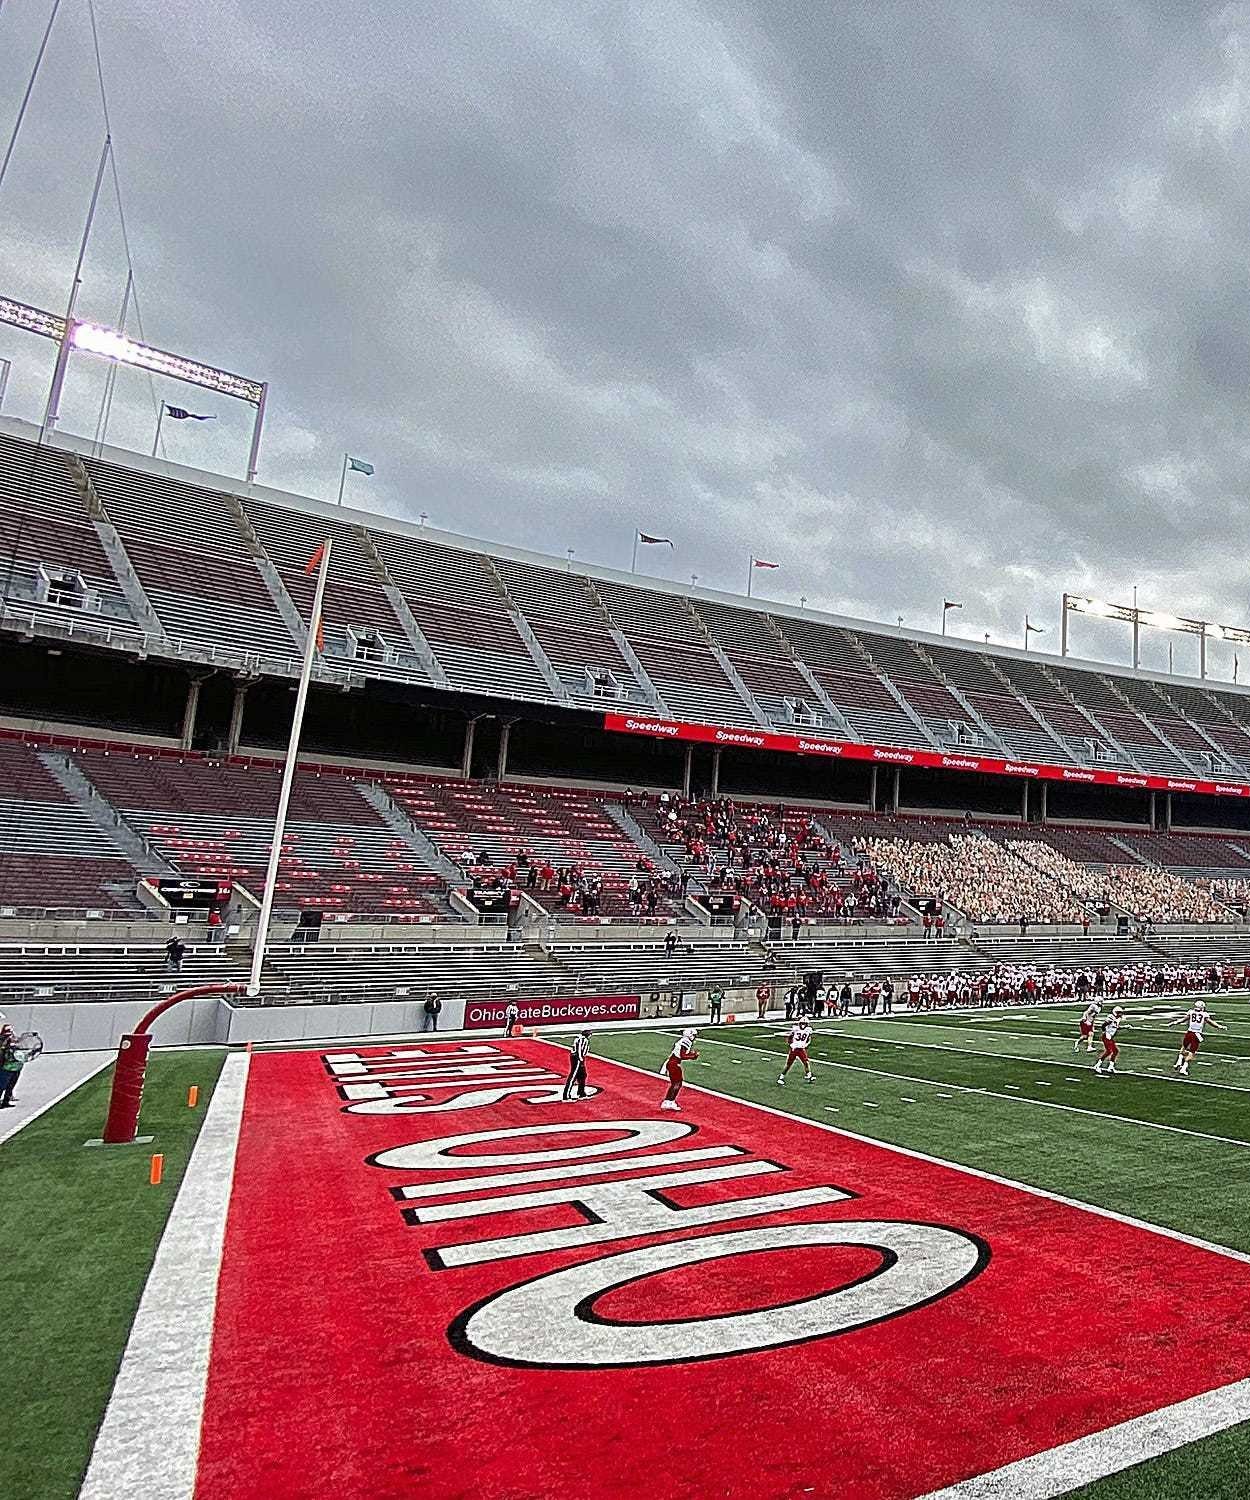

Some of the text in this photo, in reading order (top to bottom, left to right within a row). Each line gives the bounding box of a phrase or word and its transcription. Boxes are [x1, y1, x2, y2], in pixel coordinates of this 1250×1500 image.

[625, 719, 679, 736] Speedway
[715, 730, 765, 745] Speedway
[798, 740, 842, 754] Speedway
[873, 749, 913, 762] Speedway
[942, 756, 979, 769] Speedway
[1004, 763, 1039, 776] Speedway
[1062, 769, 1095, 781] Speedway
[1117, 775, 1148, 786] Speedway
[1167, 780, 1196, 791] Speedway
[1215, 784, 1243, 795] Speedway
[1191, 1013, 1204, 1023] 83
[320, 1043, 606, 1115] STATE
[363, 1119, 992, 1371] OHIO
